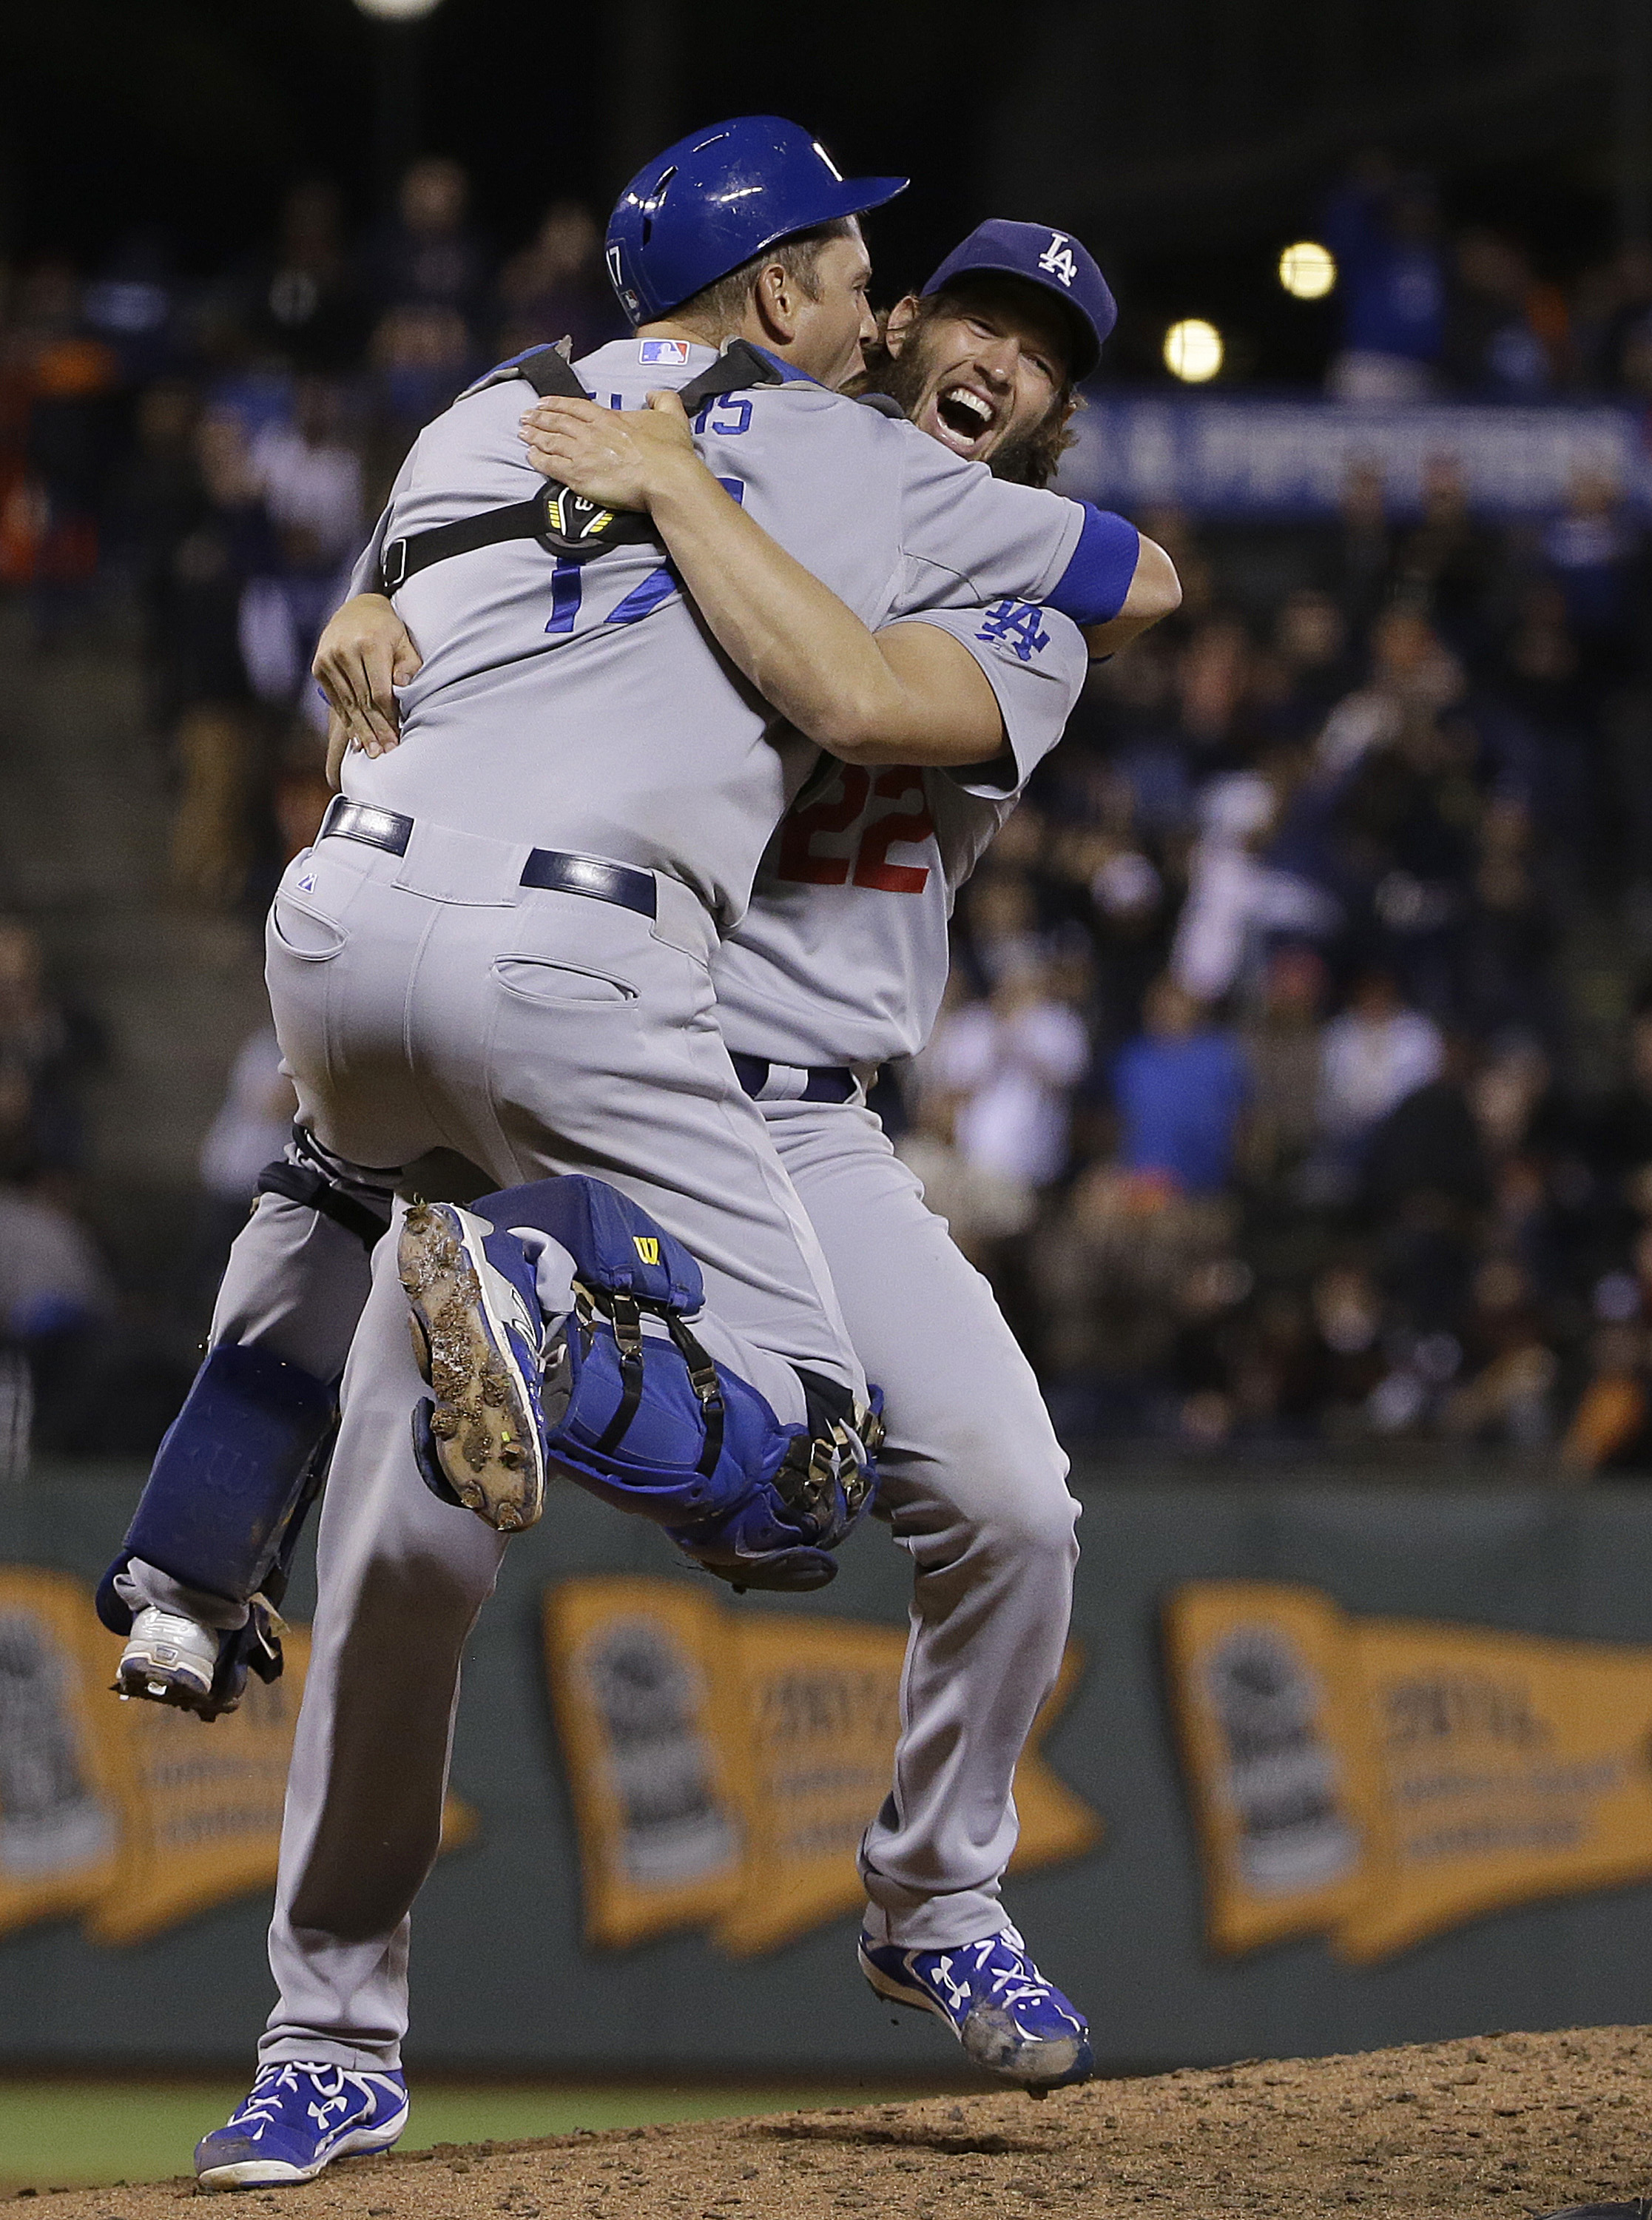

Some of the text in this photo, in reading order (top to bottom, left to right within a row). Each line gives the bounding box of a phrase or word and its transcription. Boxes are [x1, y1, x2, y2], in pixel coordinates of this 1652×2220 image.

[606, 246, 622, 287] 17
[1038, 232, 1077, 287] LA
[974, 600, 1051, 662] LA
[777, 762, 934, 895] 22
